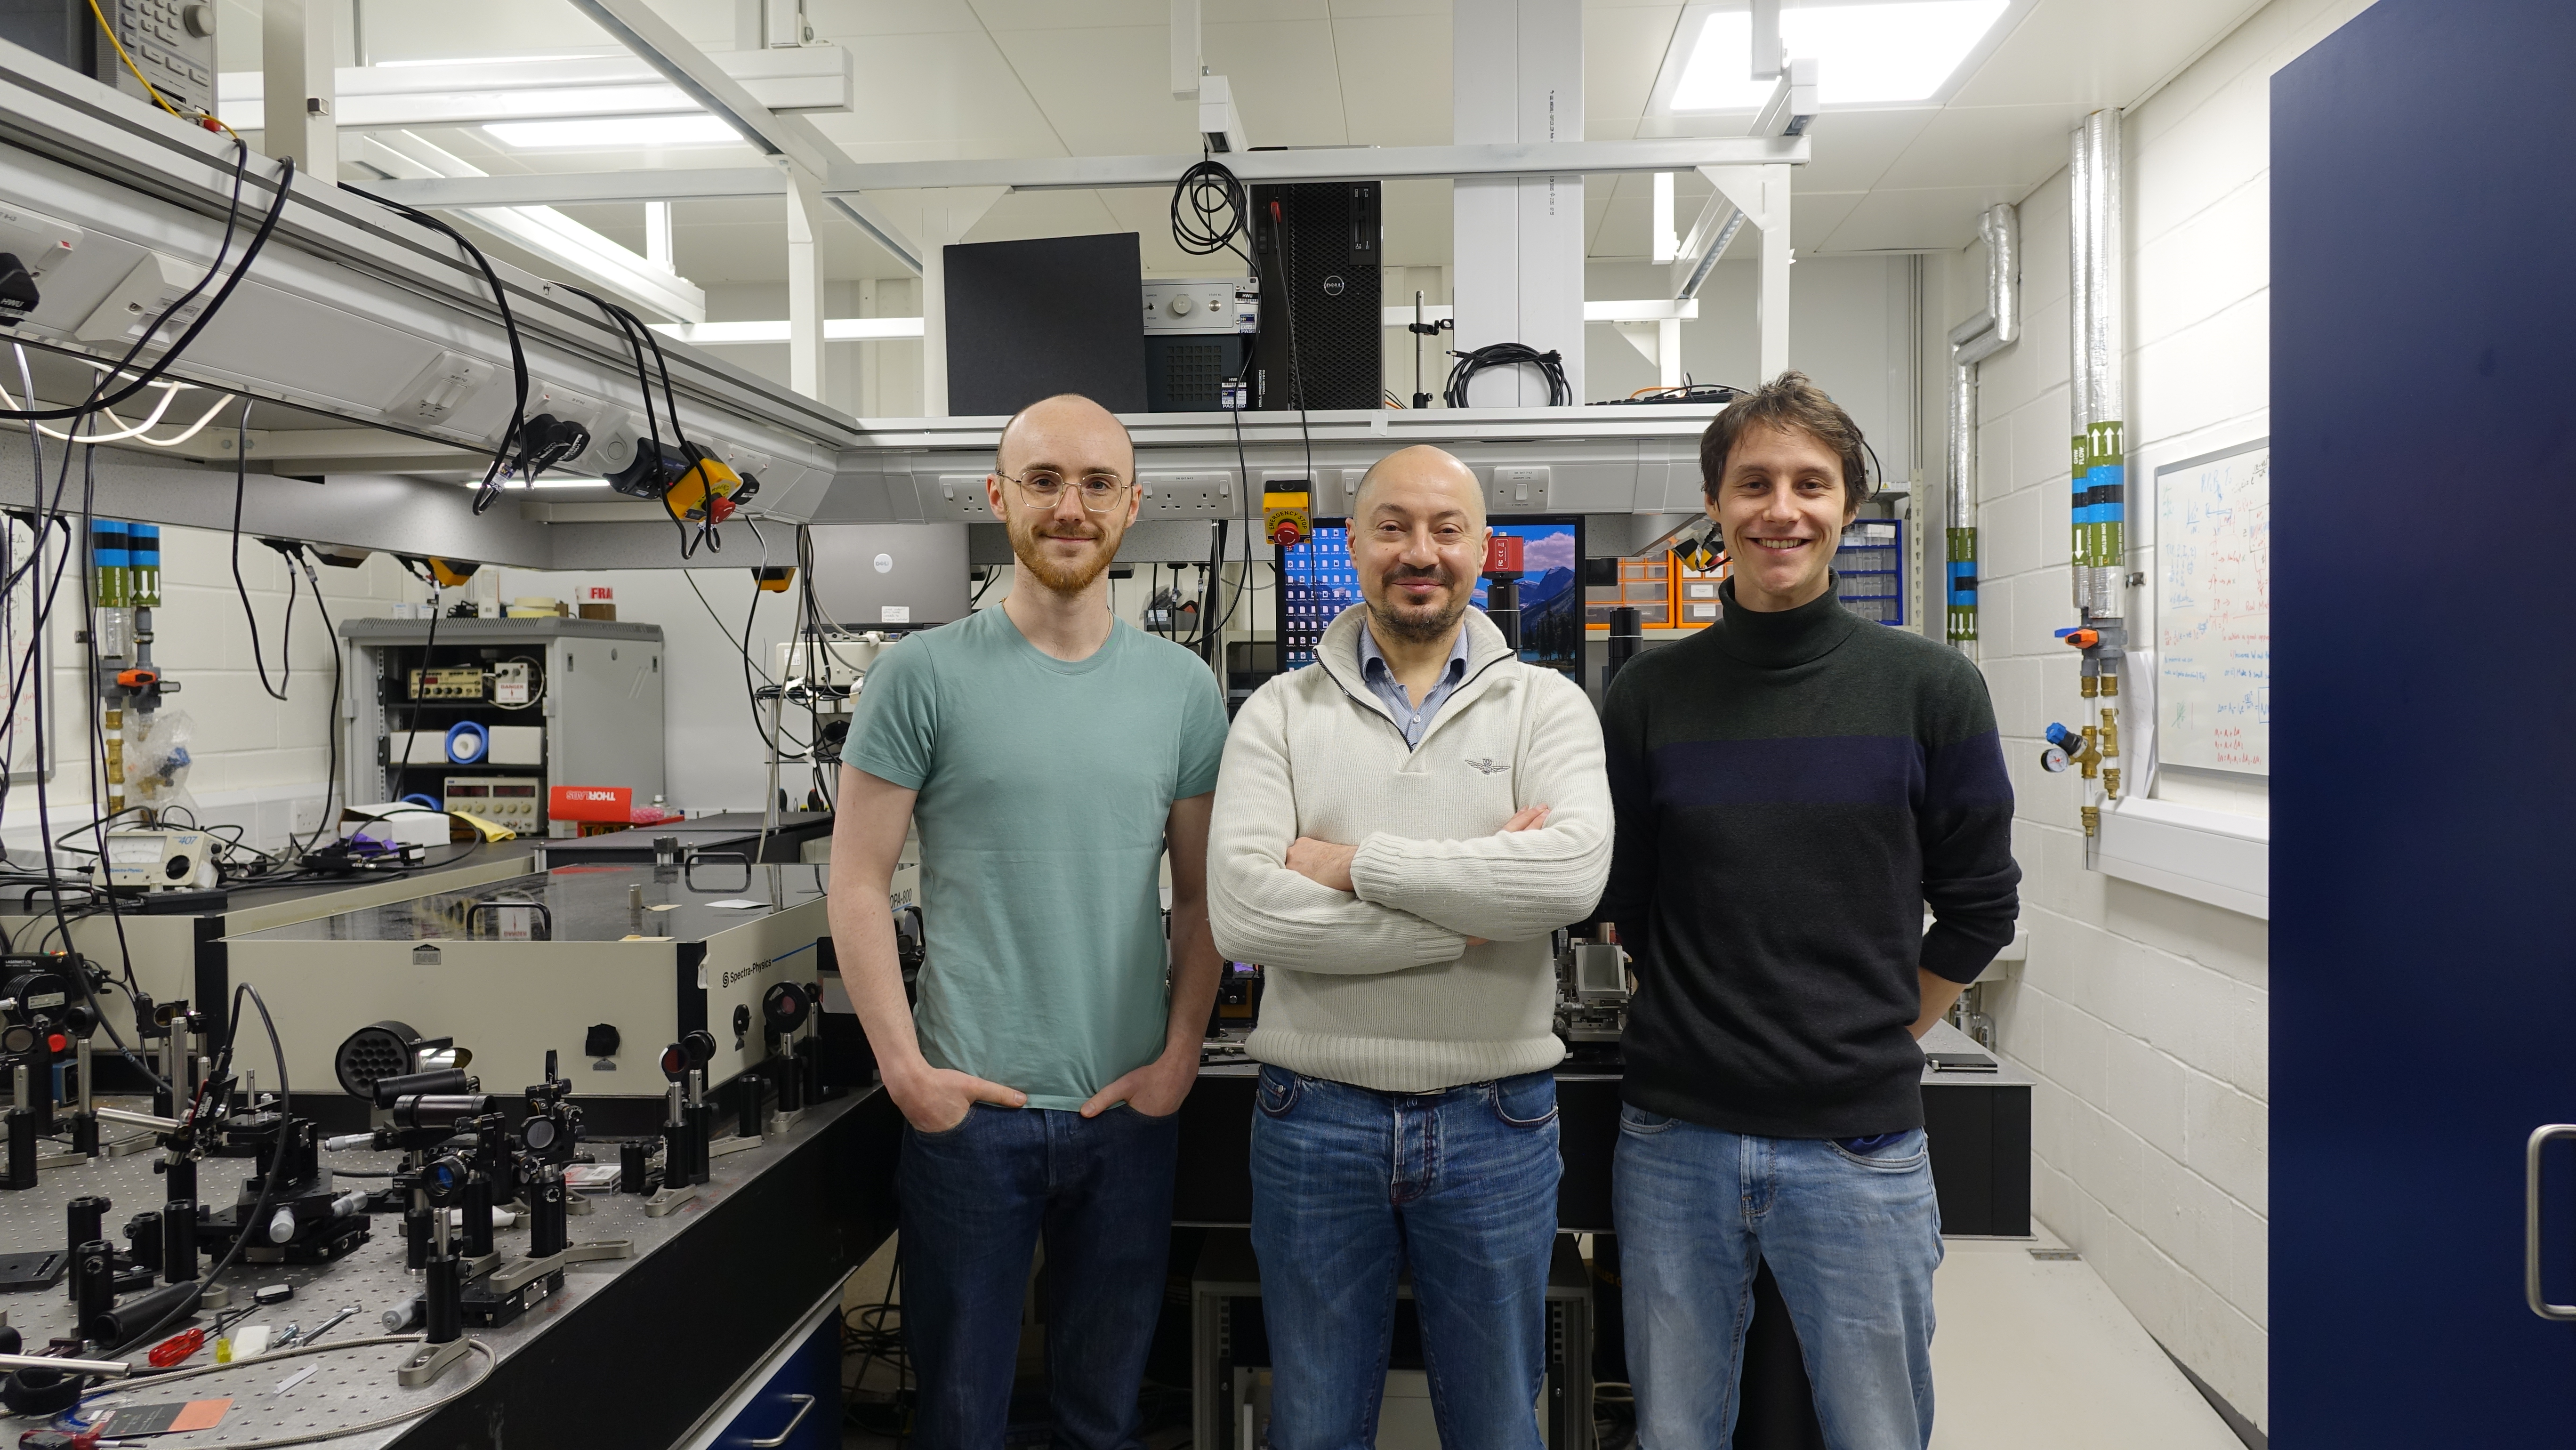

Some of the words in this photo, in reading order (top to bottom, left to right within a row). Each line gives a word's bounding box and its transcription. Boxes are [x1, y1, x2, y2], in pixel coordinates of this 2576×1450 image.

[0, 298, 24, 307] HWU
[1269, 511, 1298, 530] EMERGENCY
[1297, 516, 1307, 530] STOP
[566, 790, 616, 801] THORLABS
[178, 836, 197, 845] 407
[889, 887, 912, 909] OPA-800
[730, 959, 772, 984] Spectra-Physics
[568, 1107, 583, 1120] THORLABS
